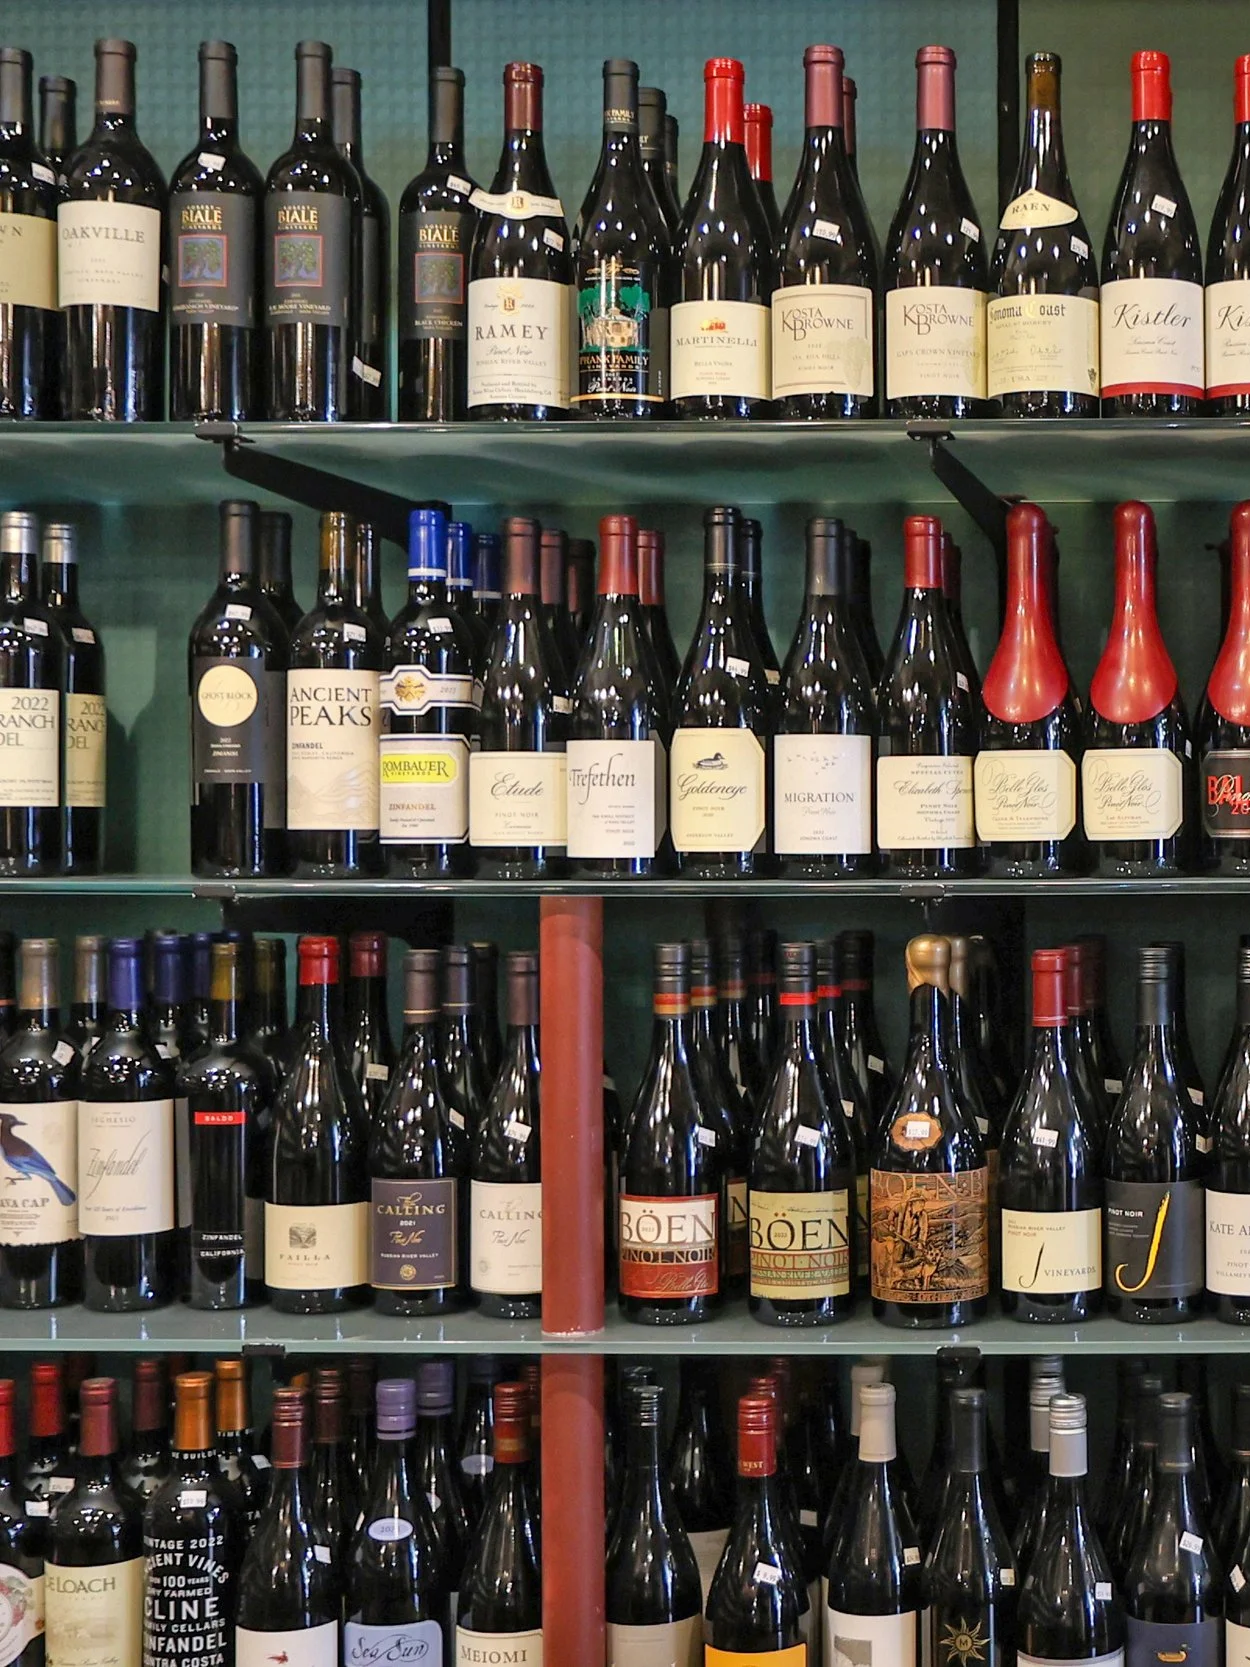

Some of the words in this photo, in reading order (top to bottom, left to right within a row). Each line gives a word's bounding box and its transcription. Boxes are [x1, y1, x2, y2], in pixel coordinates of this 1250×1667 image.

[1011, 203, 1052, 215] RAEN
[181, 210, 223, 224] BIALE
[277, 210, 318, 224] BIALE
[62, 226, 146, 245] OAKVILLE
[419, 229, 459, 243] BIALE
[781, 307, 824, 333] KOSTA
[903, 304, 948, 326] KOSTA
[1112, 302, 1192, 330] Kistler
[793, 317, 854, 341] BROWNE
[917, 314, 975, 336] BROWNE
[475, 324, 549, 342] RAMEY
[675, 336, 758, 348] MARTINELLI
[579, 355, 611, 366] FRANK
[611, 355, 650, 367] FAMILY
[290, 687, 373, 703] ANCIENT
[11, 696, 49, 711] 2022
[0, 714, 55, 730] RANCH
[290, 705, 372, 727] PEAKS
[67, 718, 106, 733] RANC
[291, 742, 324, 750] ZINFANDEL
[382, 760, 450, 778] ROMBAUER
[490, 771, 545, 798] Etude
[569, 753, 636, 805] Trefethen
[676, 772, 748, 801] Goldeneye
[893, 780, 945, 797] Elizabeth
[783, 791, 855, 804] MIGRATION
[388, 803, 437, 812] ZINFANDEL
[22, 1198, 50, 1208] CAP
[376, 1203, 446, 1215] CALLING
[1125, 1209, 1143, 1217] NOIR
[620, 1209, 715, 1245] BÖEN
[750, 1212, 850, 1251] BÖEN
[1209, 1220, 1235, 1235] KATE
[200, 1248, 244, 1257] CALIFORNIA
[279, 1253, 331, 1262] FAILLA
[1044, 1265, 1096, 1278] VINEYARDS
[190, 1535, 224, 1550] 2022
[188, 1553, 229, 1584] VINES
[163, 1576, 186, 1588] 100
[164, 1587, 213, 1598] FARMED
[145, 1596, 220, 1621] CLINE
[171, 1618, 226, 1633] CELLARS
[150, 1632, 227, 1653] NFANDEL
[351, 1636, 380, 1660] Sea
[386, 1634, 428, 1661] Sun
[958, 1638, 970, 1647] M
[181, 1653, 225, 1667] COSTA
[460, 1644, 528, 1664] MEIOMI
